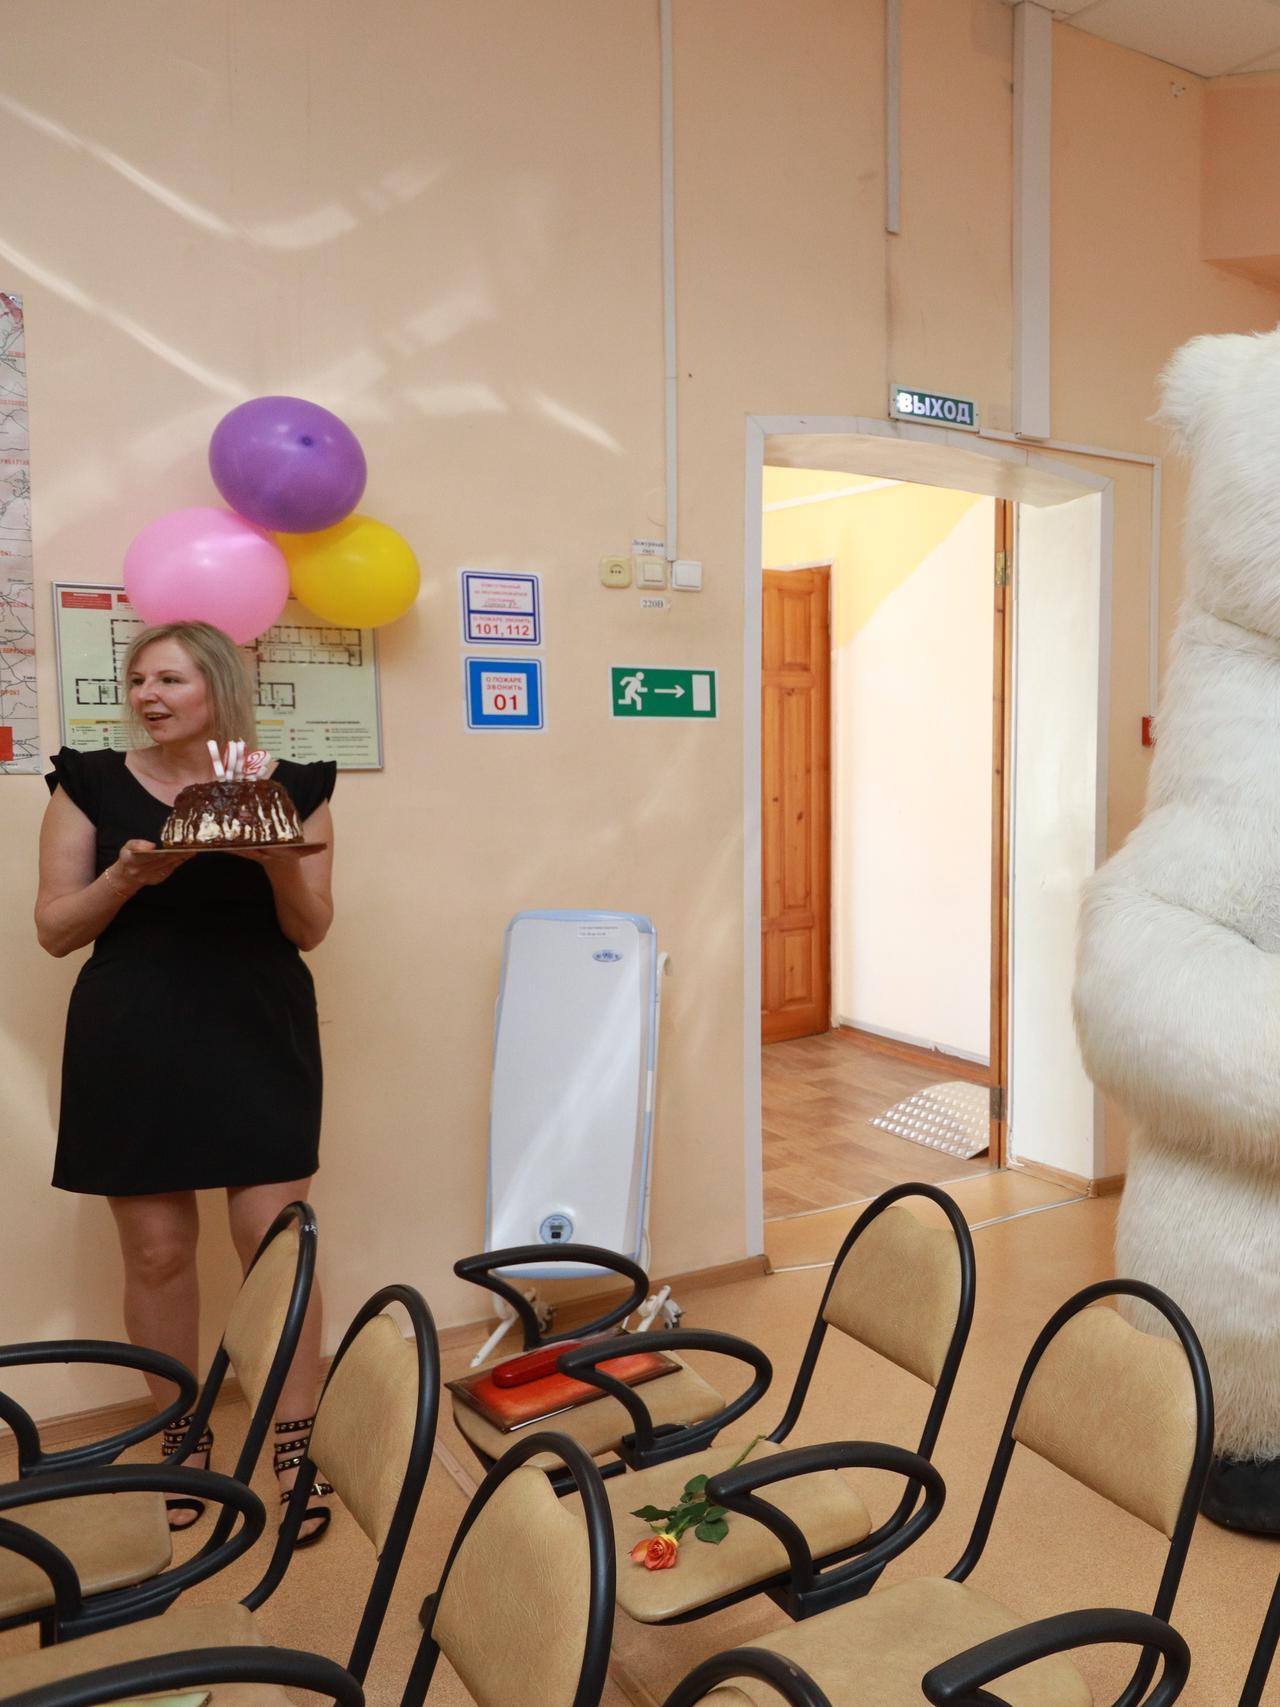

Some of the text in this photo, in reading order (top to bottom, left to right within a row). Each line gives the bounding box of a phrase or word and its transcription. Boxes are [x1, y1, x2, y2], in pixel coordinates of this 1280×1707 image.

[896, 392, 971, 424] ВЫХОД
[492, 676, 523, 684] ПОЖАРЕ
[494, 694, 518, 711] 01
